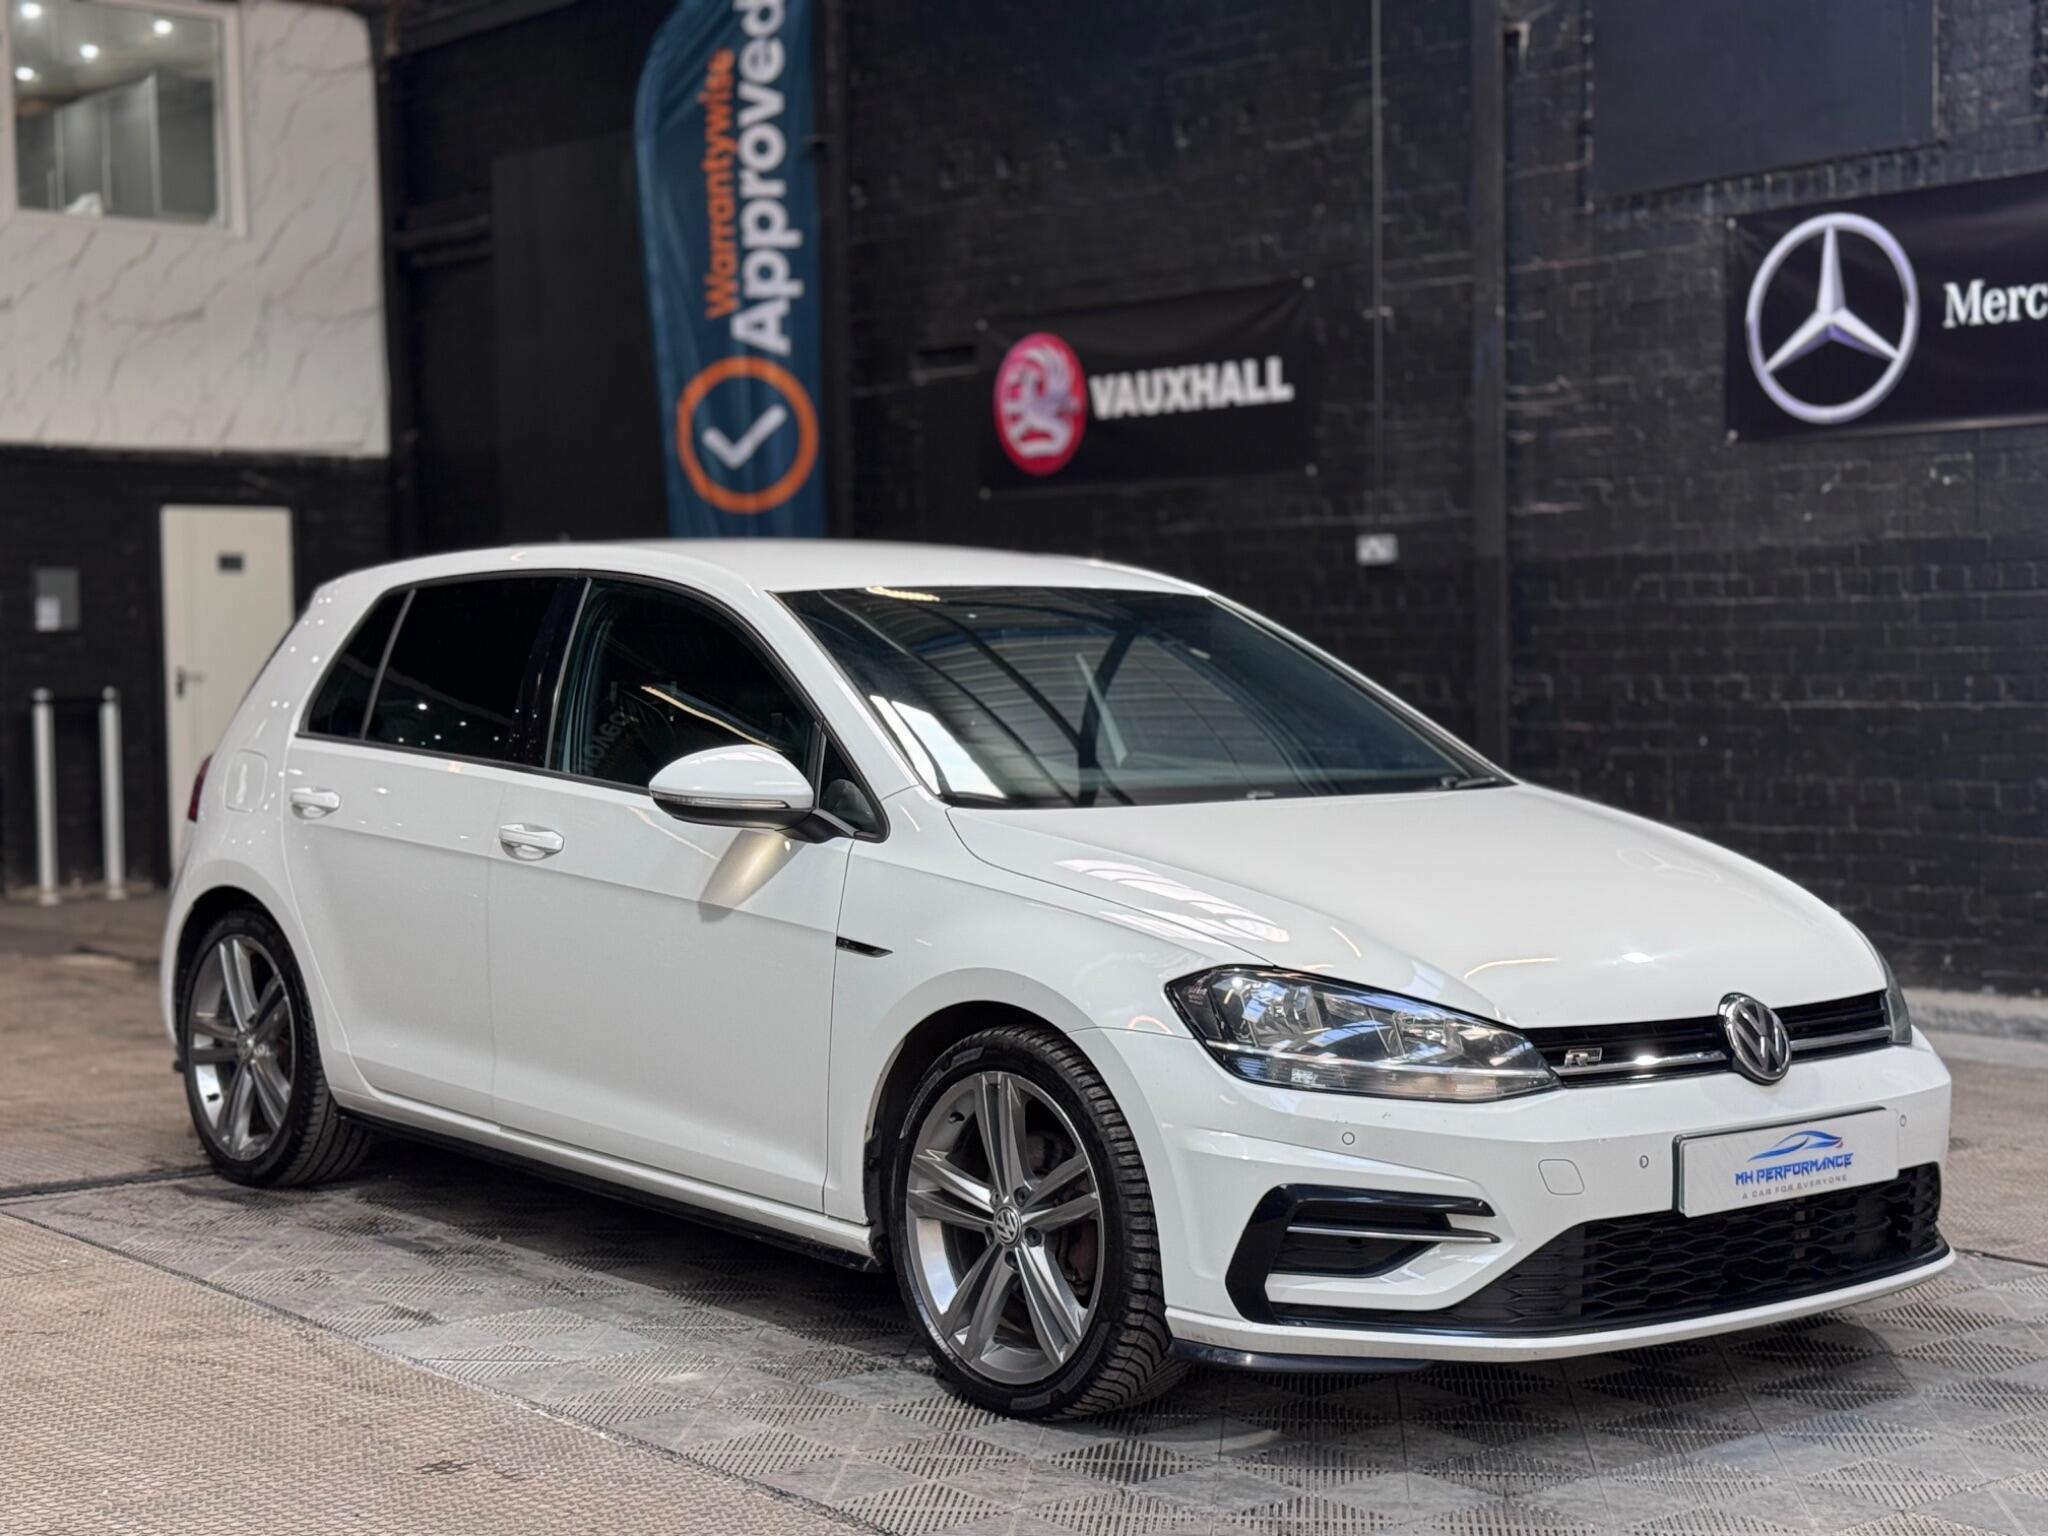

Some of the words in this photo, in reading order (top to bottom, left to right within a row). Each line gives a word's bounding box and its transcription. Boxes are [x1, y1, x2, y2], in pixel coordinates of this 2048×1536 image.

[699, 48, 739, 319] Warrantywise
[730, 0, 803, 356] Approved
[1942, 278, 2048, 329] Merc
[1089, 355, 1295, 420] VAUXHALL
[1735, 1170, 1754, 1186] MH
[1756, 1153, 1854, 1184] PERFORMANCE
[1797, 1174, 1847, 1191] EVERYONE
